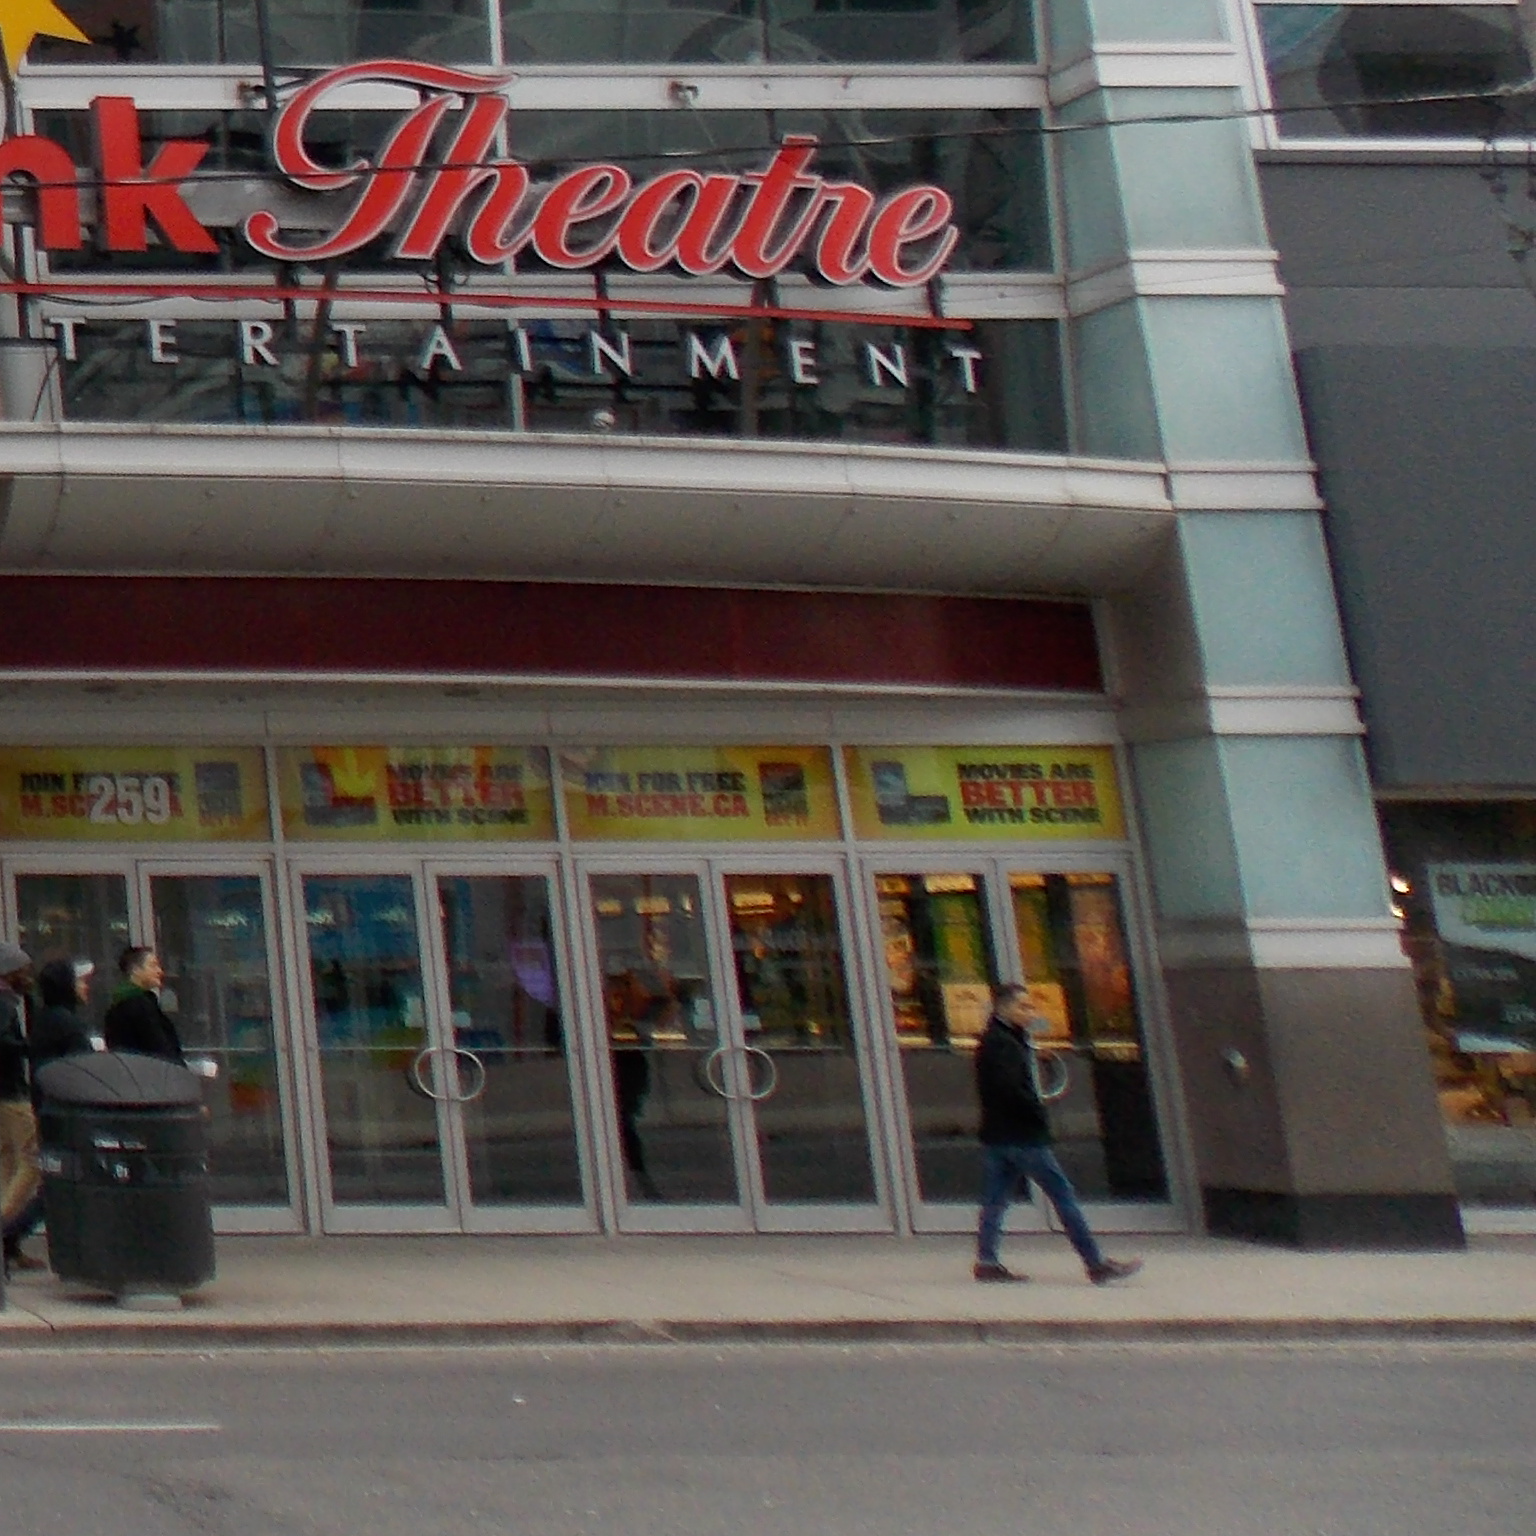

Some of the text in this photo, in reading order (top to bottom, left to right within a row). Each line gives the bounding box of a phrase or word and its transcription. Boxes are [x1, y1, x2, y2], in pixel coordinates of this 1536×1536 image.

[244, 59, 959, 288] Theatre
[687, 772, 747, 792] FREE
[957, 763, 1095, 780] MOVIES ARE
[88, 775, 171, 825] 259
[586, 793, 751, 818] M.SCENE.CA
[960, 780, 1098, 807] BETTER
[964, 807, 1102, 823] WITH SCENE
